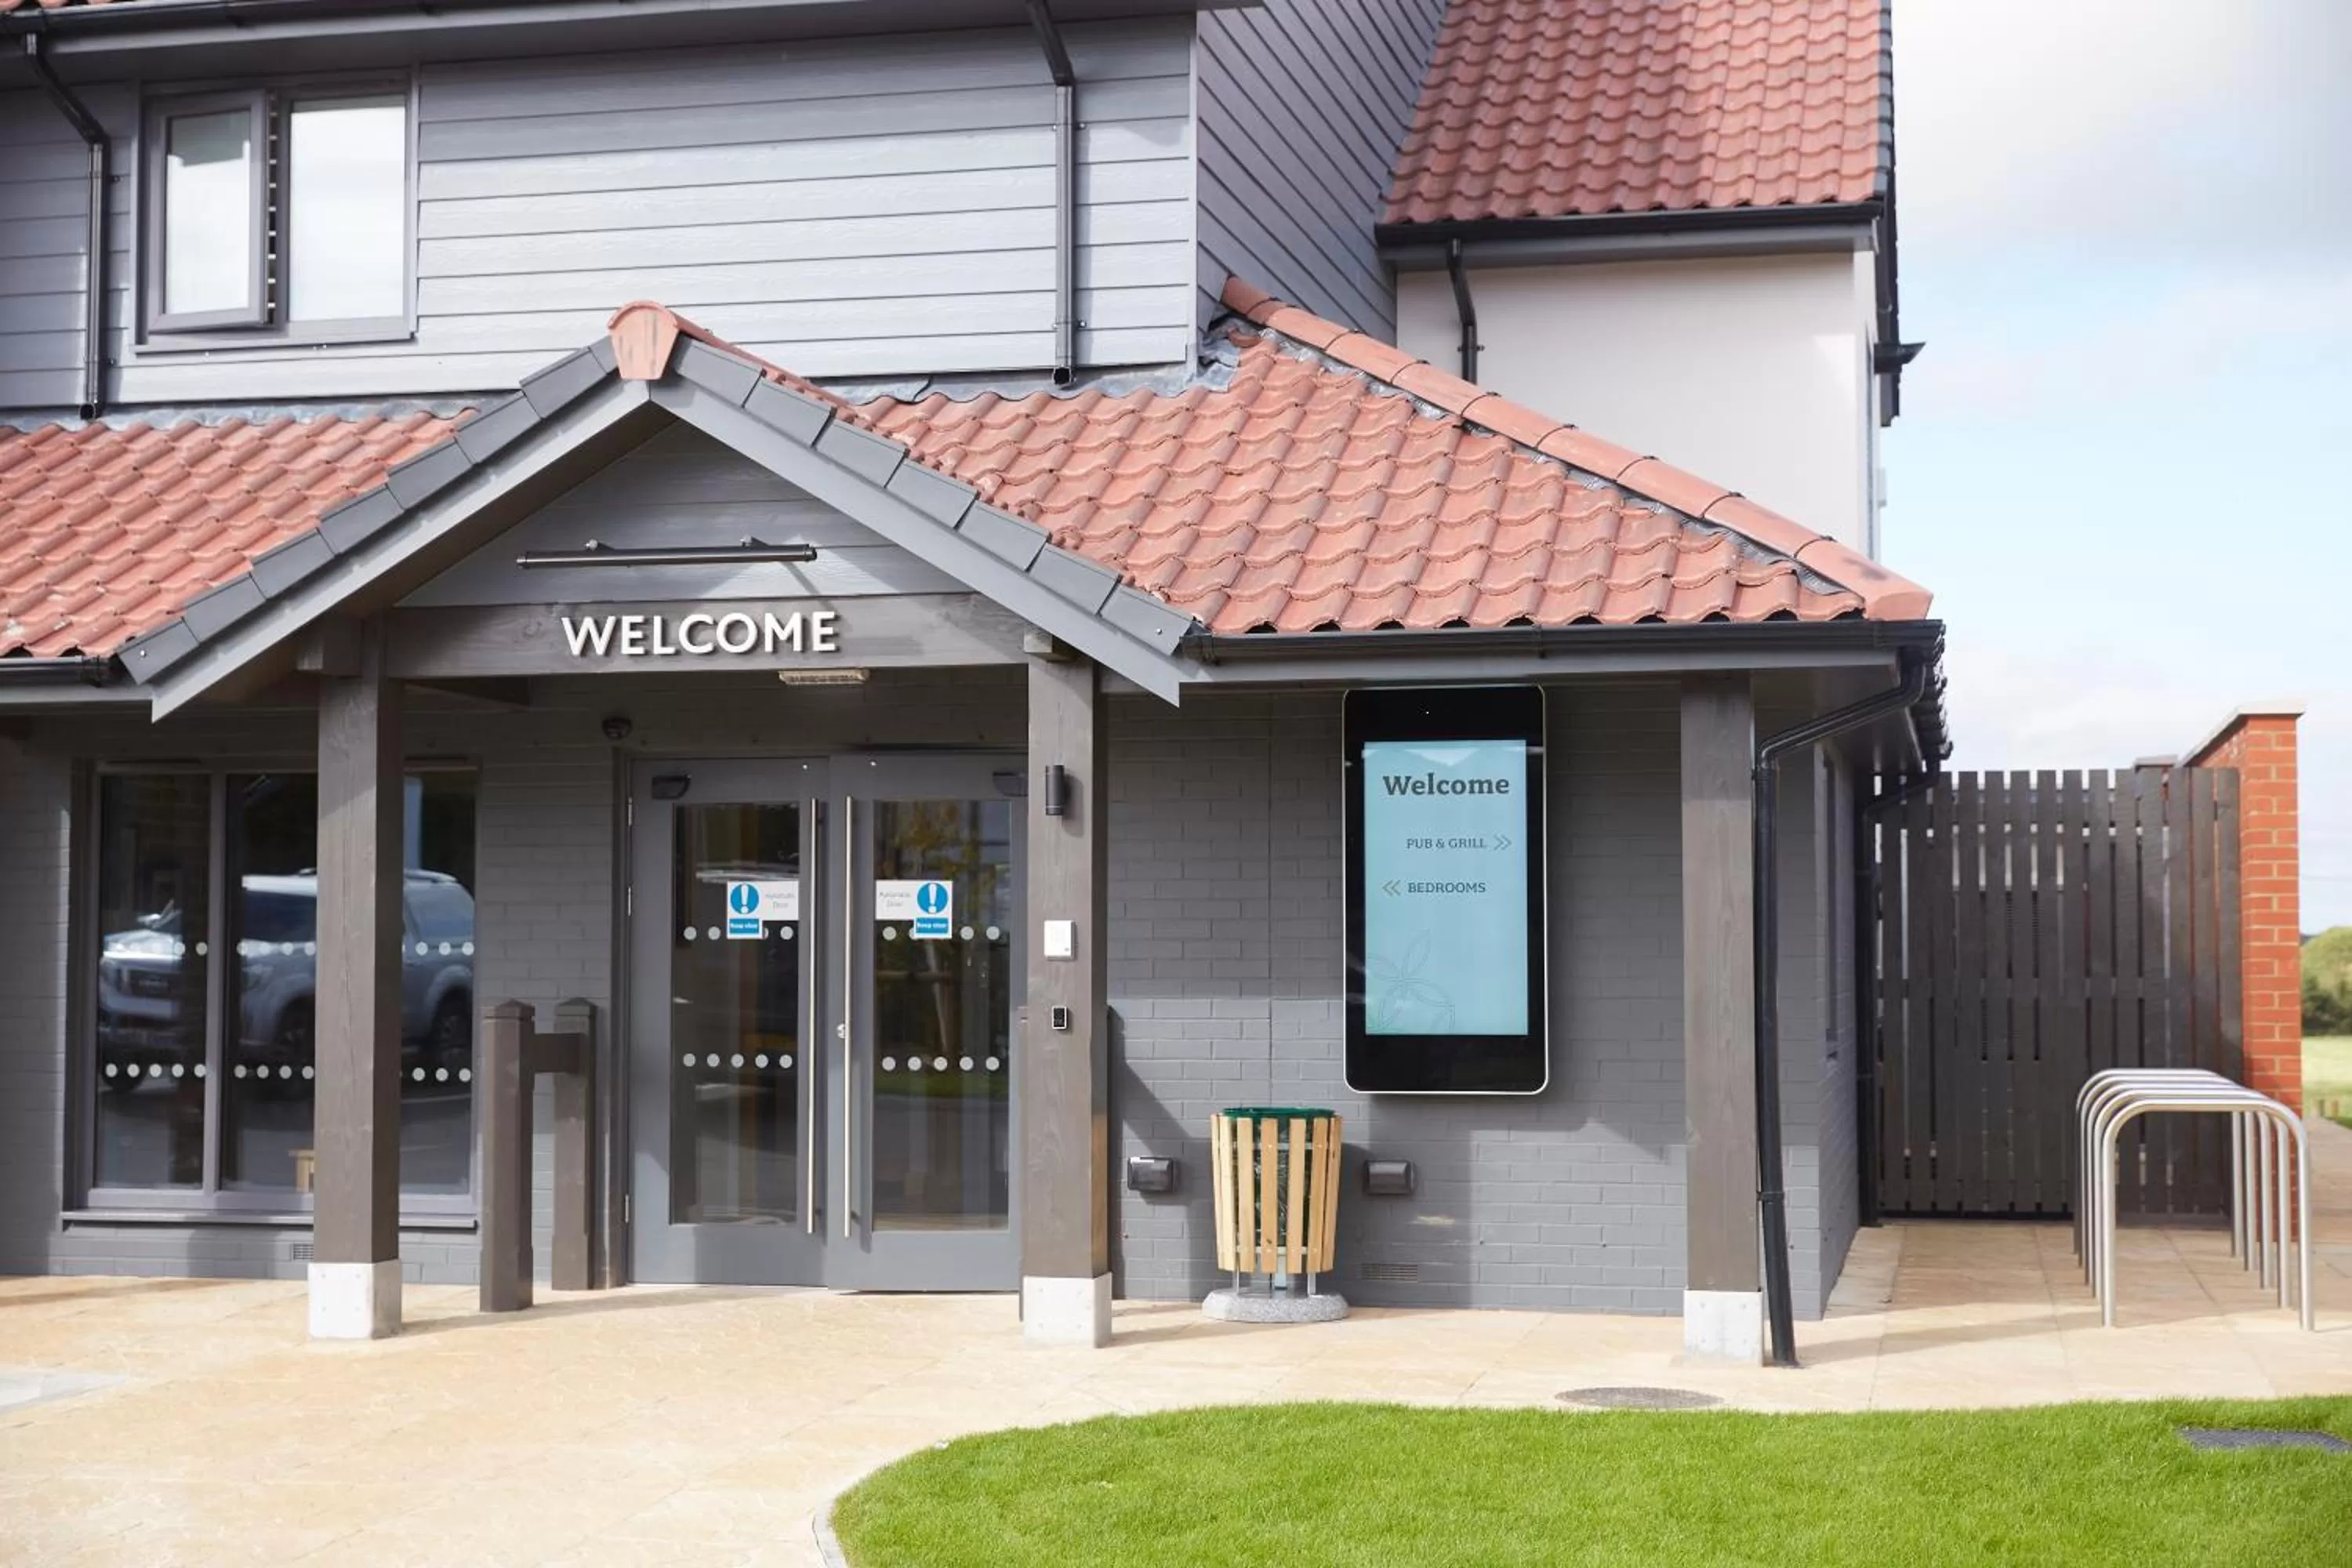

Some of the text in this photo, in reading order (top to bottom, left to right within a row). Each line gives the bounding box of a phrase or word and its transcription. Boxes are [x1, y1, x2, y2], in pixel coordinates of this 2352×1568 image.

[561, 611, 837, 656] WELCOME
[1382, 772, 1510, 796] Welcome
[1406, 837, 1486, 849] PUB & GRILL
[1407, 882, 1486, 893] BEDROOMS
